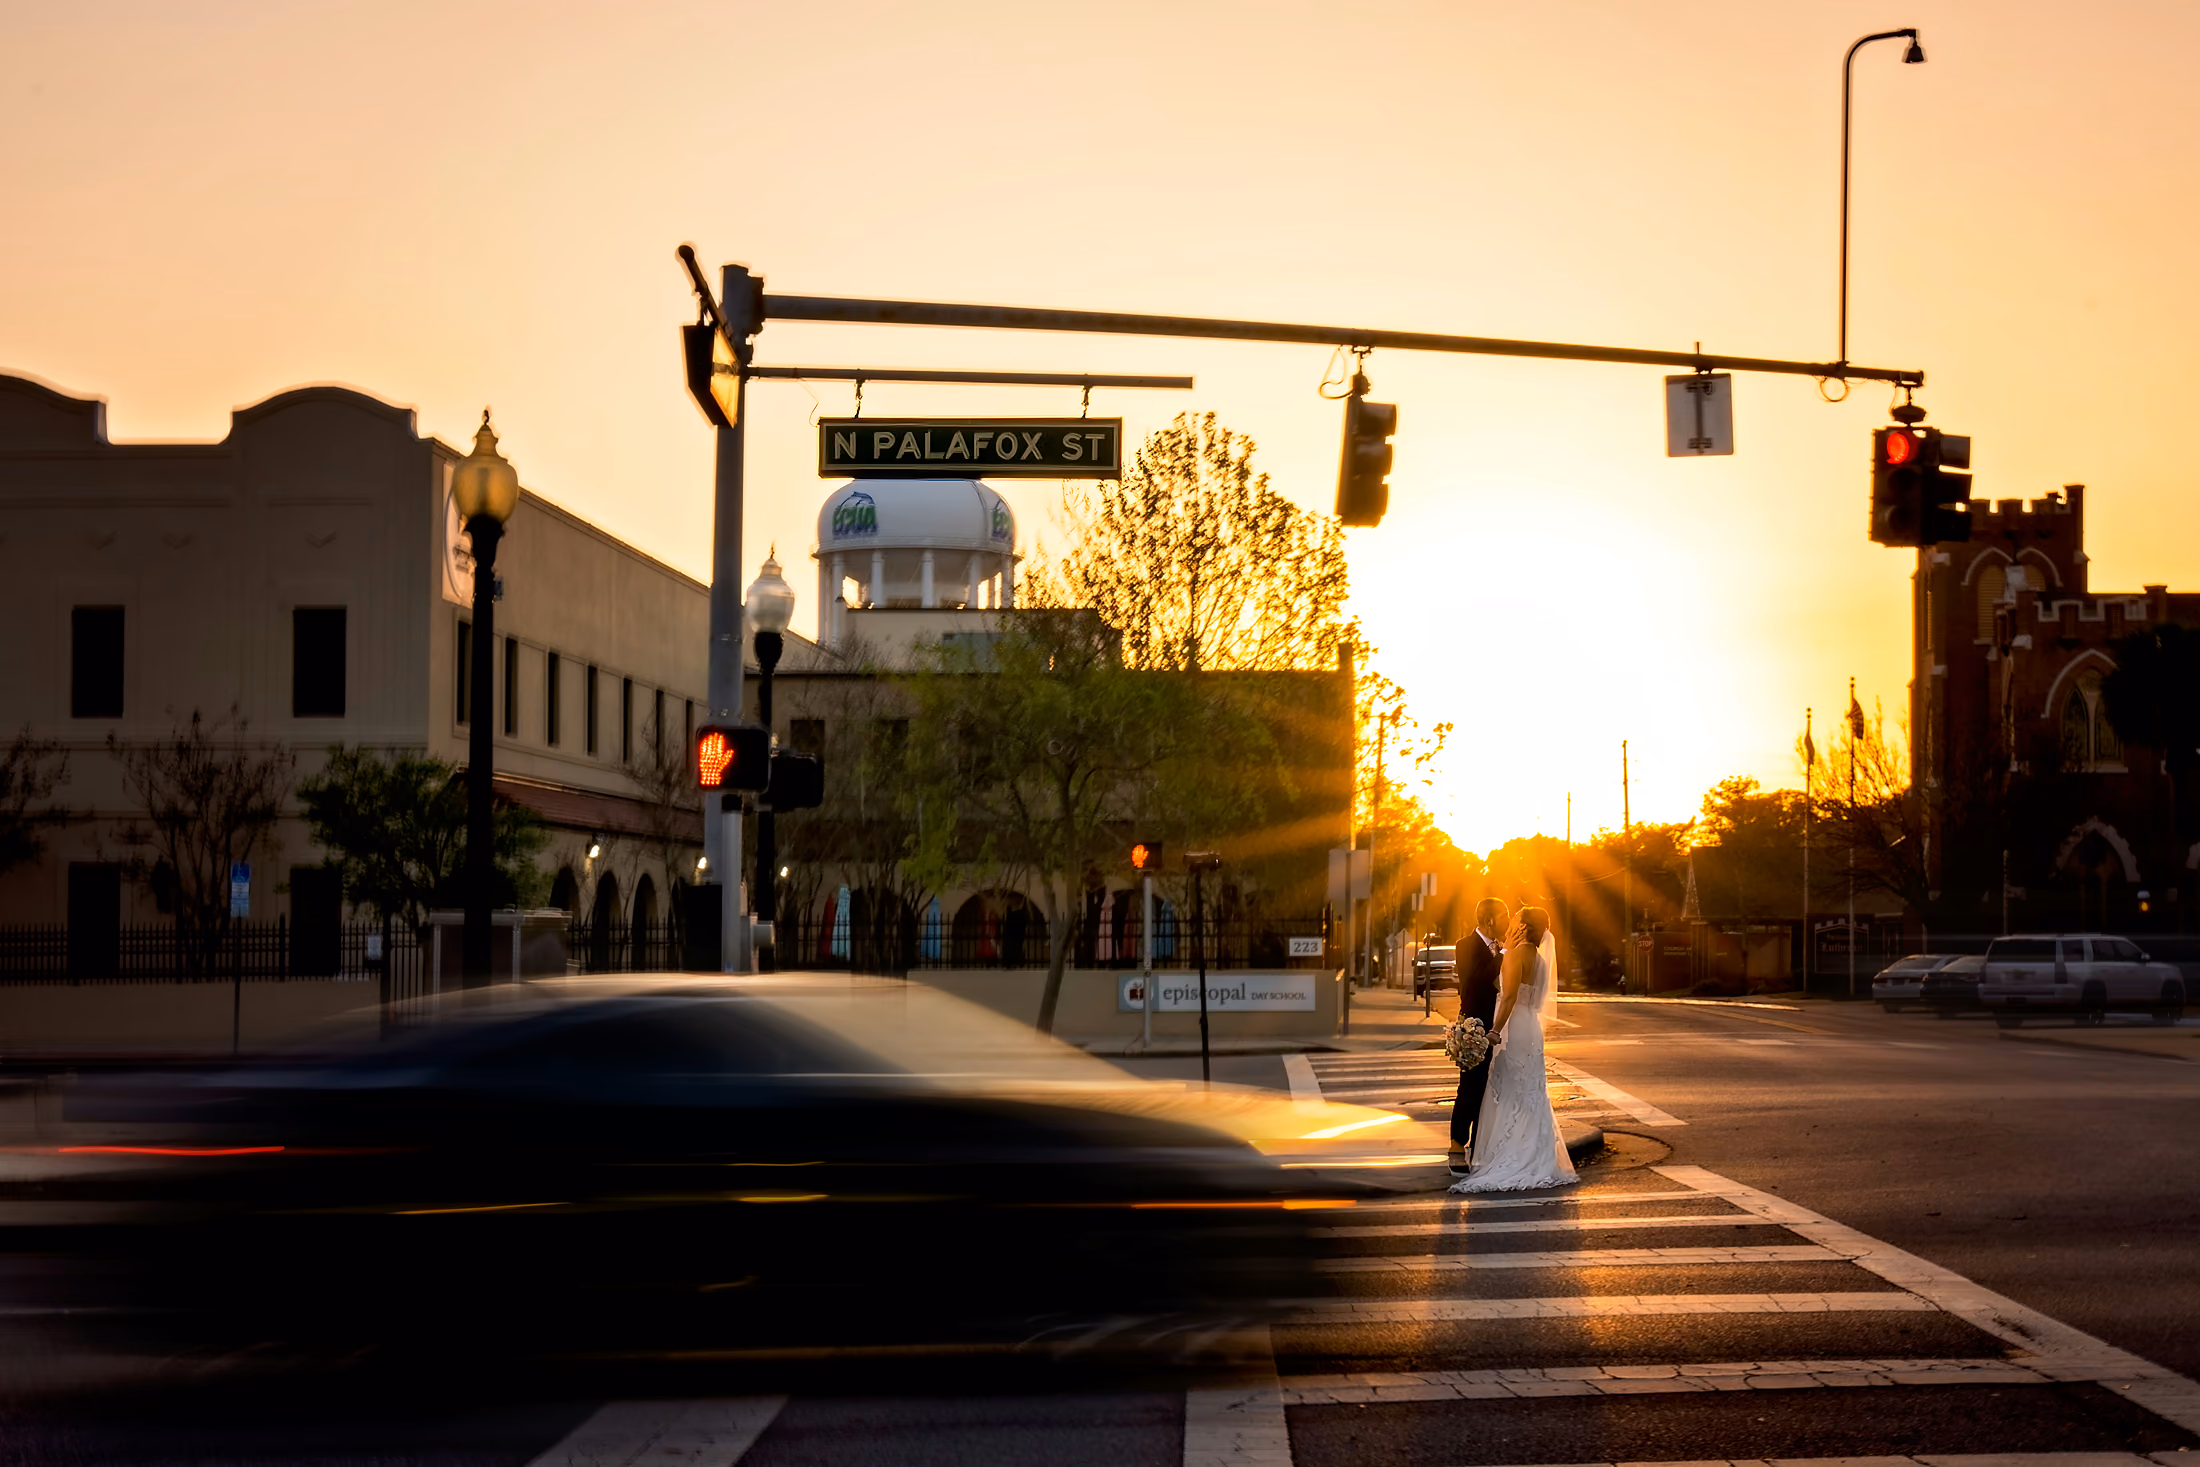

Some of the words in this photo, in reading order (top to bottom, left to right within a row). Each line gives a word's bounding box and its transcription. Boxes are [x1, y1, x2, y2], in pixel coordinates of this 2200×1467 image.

[834, 431, 857, 460] N
[873, 430, 1043, 460] PALAFOX
[1061, 432, 1106, 461] ST
[1293, 941, 1319, 953] 223
[1163, 982, 1246, 1005] episopal
[1251, 992, 1269, 1001] DAY
[1270, 992, 1306, 1001] SCHOOL
